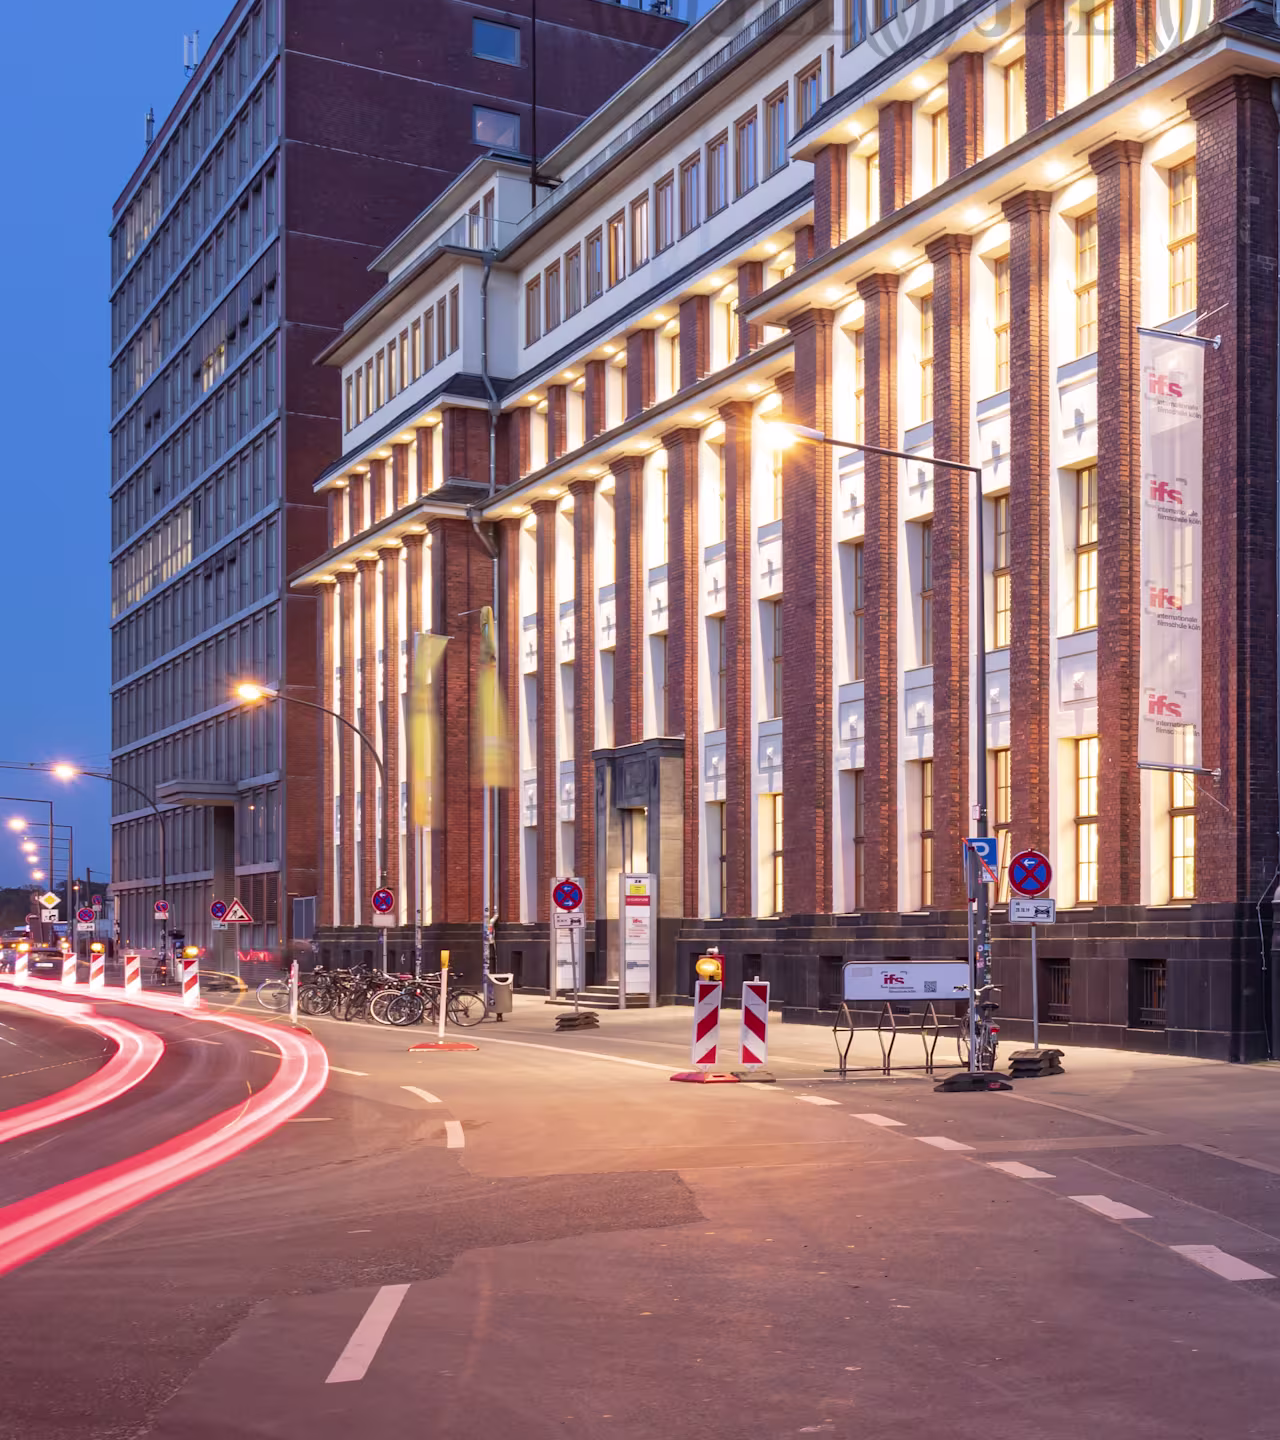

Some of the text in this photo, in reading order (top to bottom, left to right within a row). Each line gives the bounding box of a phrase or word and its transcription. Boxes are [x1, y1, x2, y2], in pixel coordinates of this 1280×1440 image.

[1150, 480, 1182, 504] ifs
[1150, 587, 1182, 610] ifs
[1149, 694, 1181, 717] ifs
[883, 974, 904, 984] ifs
